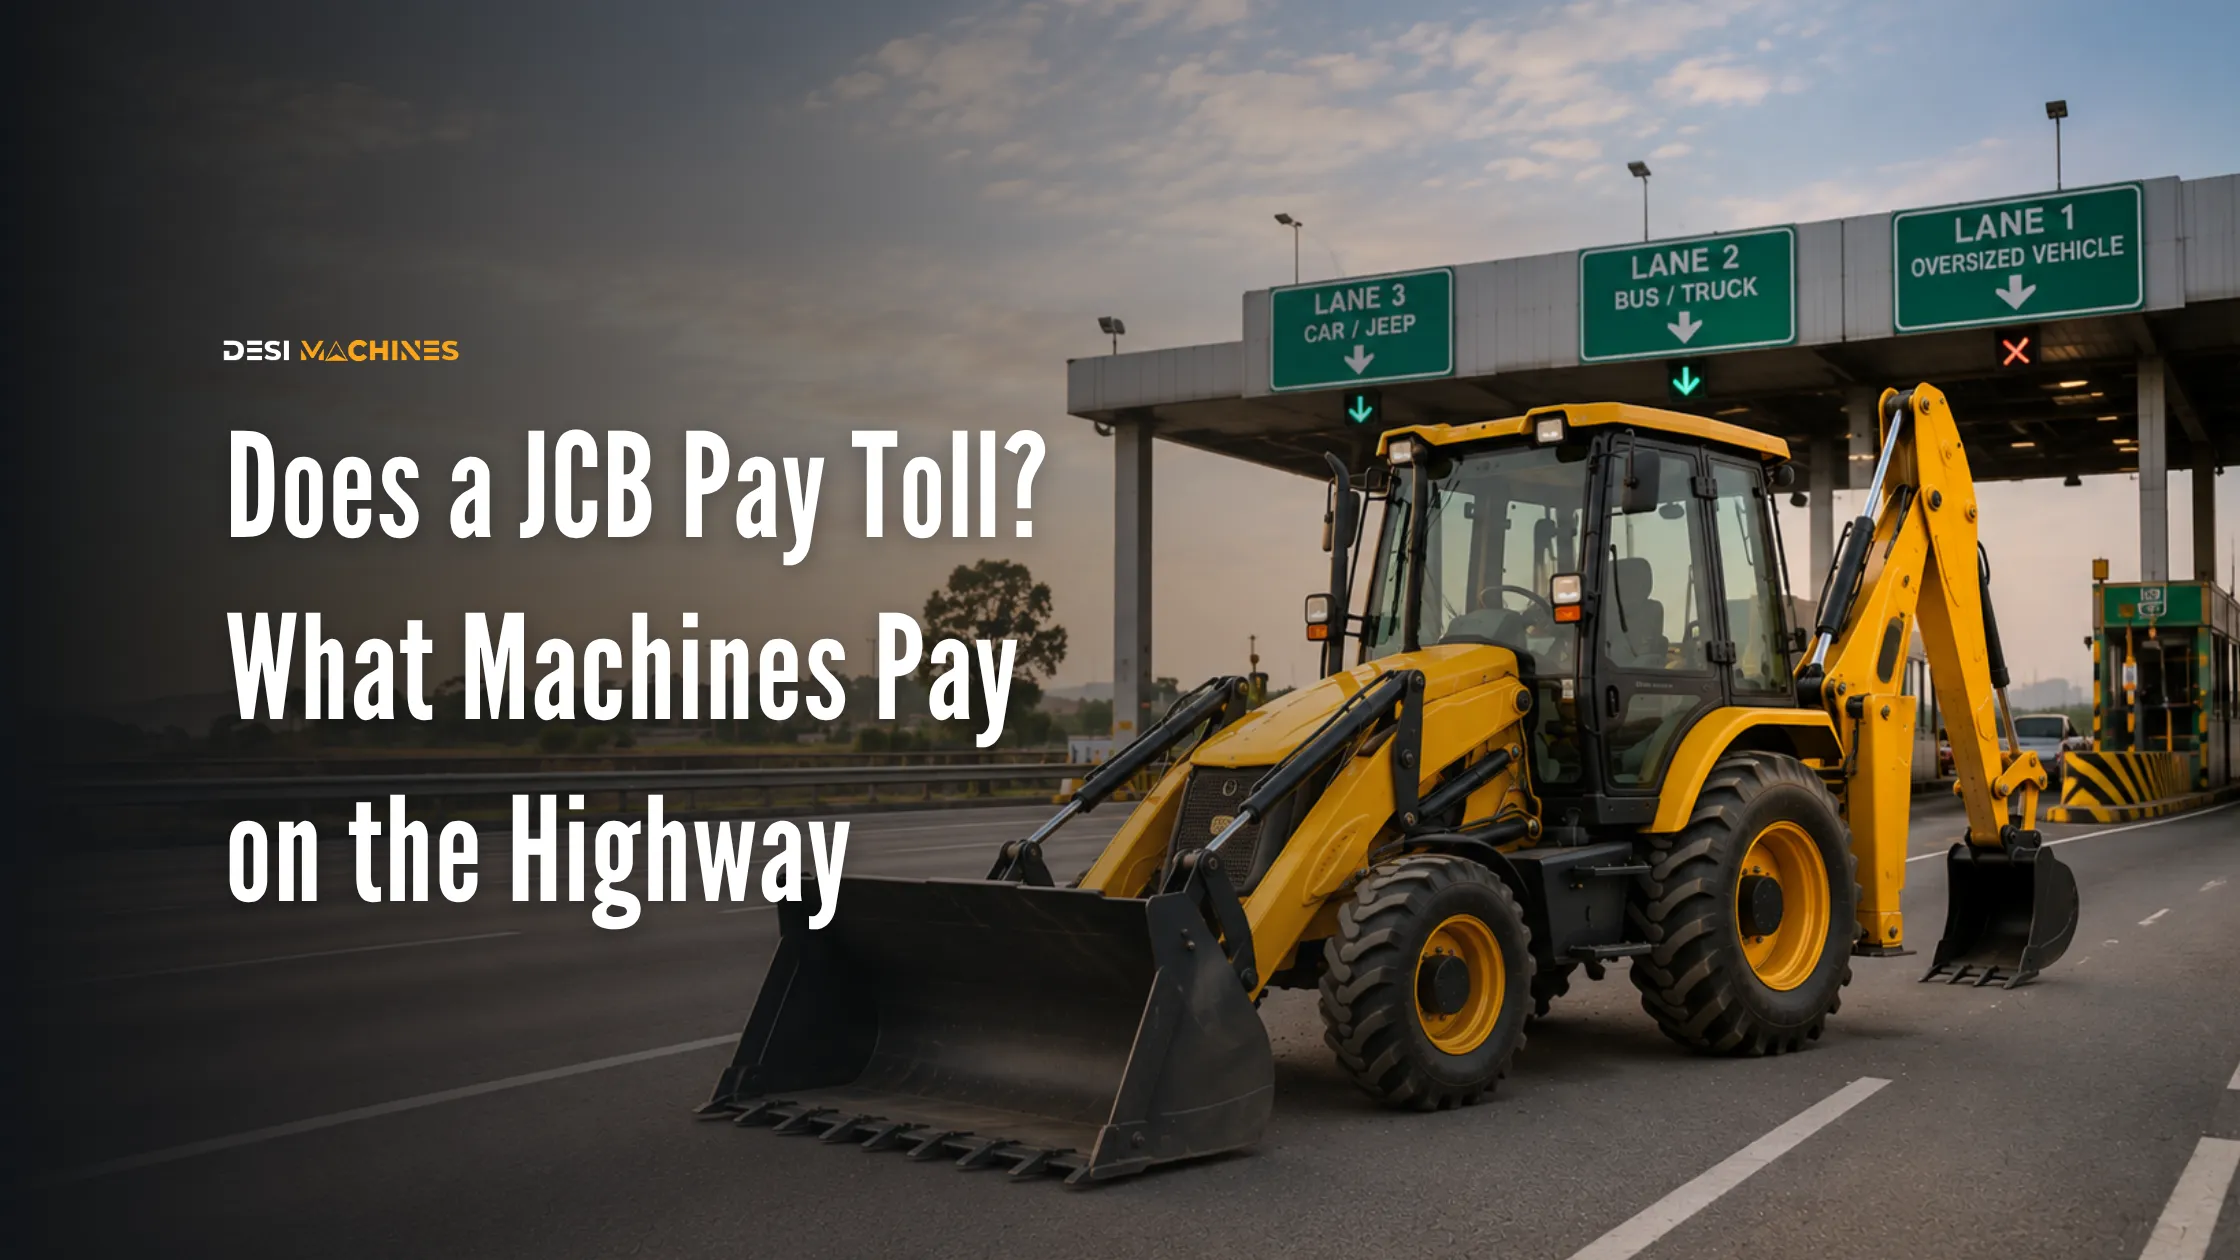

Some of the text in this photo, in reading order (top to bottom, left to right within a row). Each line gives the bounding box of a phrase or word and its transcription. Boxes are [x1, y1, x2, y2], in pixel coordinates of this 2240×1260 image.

[1956, 204, 2072, 242] LANE 1
[1633, 245, 1738, 279] LANE 2
[1912, 236, 2123, 276] OVERSIZED VEHICLE
[1316, 284, 1404, 314] LANE 3
[1616, 277, 1757, 309] BUS / TRUCK
[1305, 315, 1415, 342] CAR / JEEP
